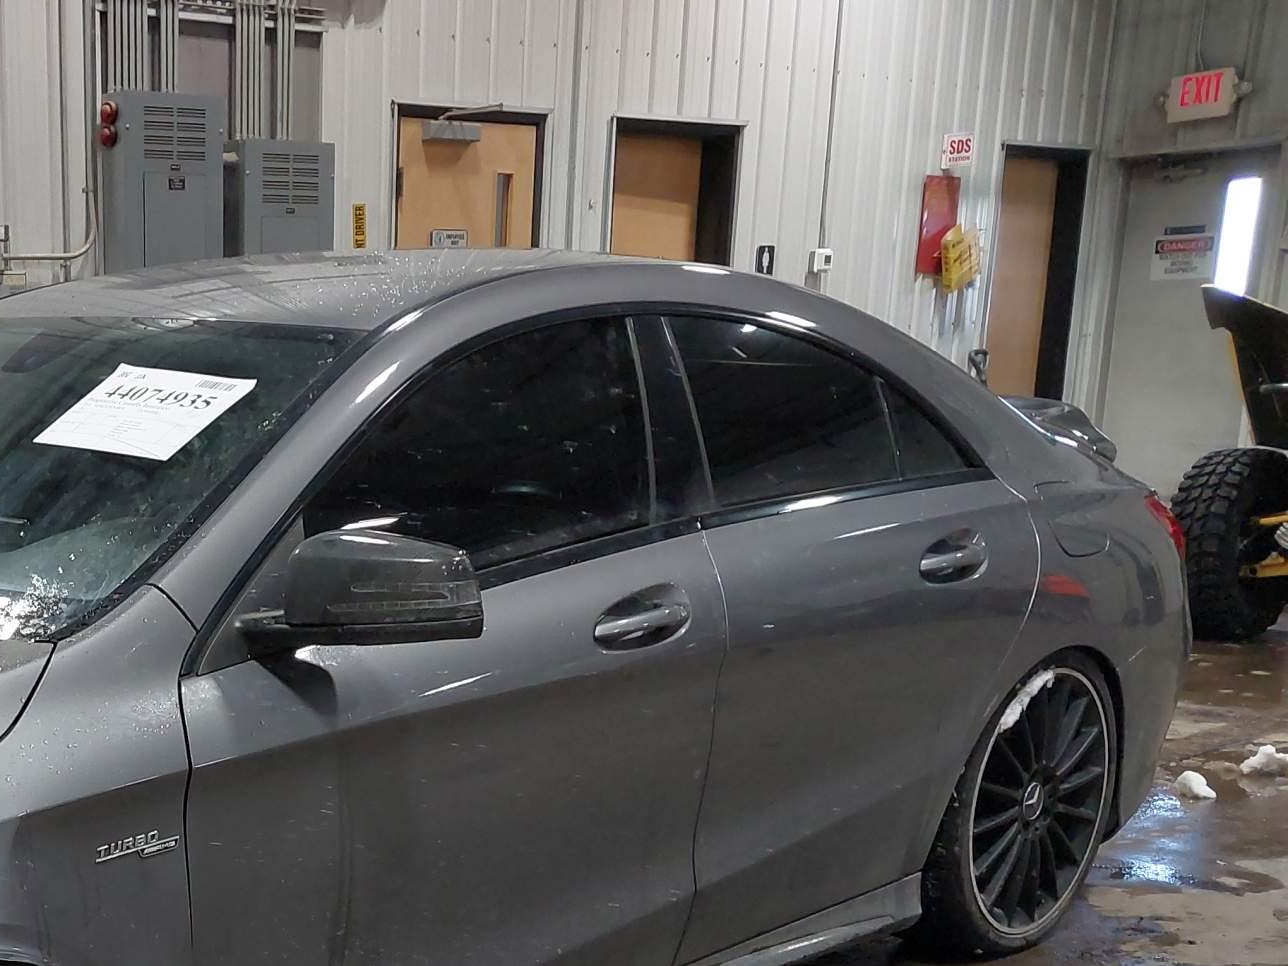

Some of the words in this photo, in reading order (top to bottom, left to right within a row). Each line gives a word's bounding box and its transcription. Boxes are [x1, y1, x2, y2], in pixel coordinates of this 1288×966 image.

[1180, 72, 1224, 107] EXIT
[949, 138, 972, 155] SDS
[355, 206, 365, 236] DRIVER
[104, 384, 218, 410] 44074935
[96, 830, 159, 858] TURBO
